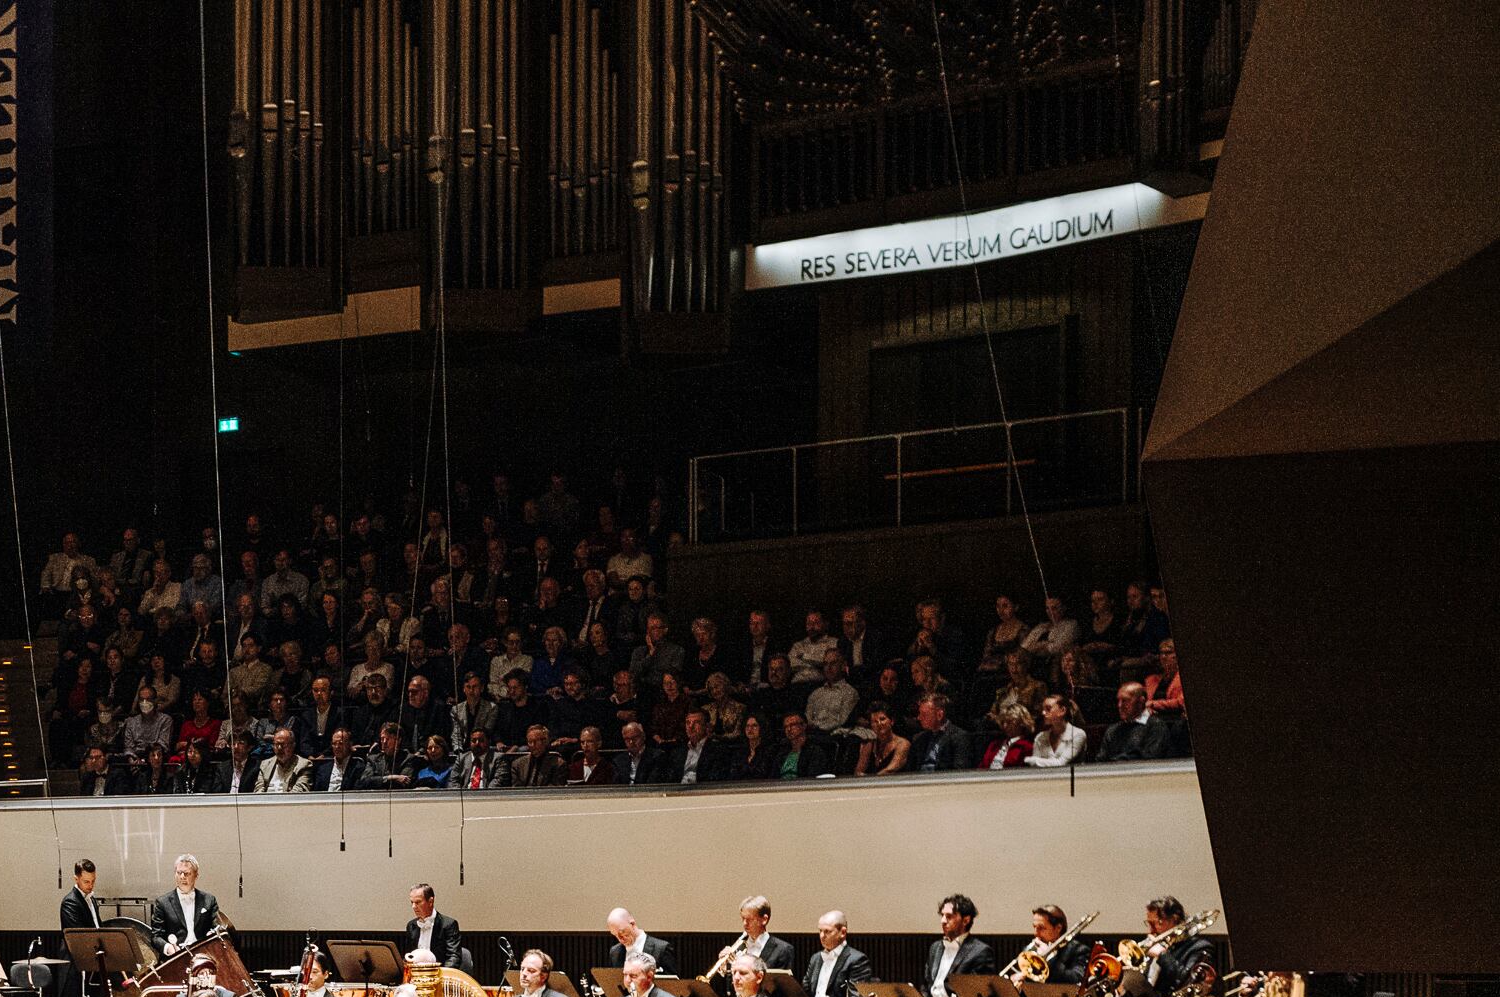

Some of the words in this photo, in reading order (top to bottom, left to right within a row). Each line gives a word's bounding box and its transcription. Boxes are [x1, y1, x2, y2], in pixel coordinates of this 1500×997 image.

[801, 255, 835, 281] RES
[844, 245, 920, 274] SEVERA
[927, 233, 1001, 262] VERUM
[1010, 208, 1114, 249] GAUDIUM
